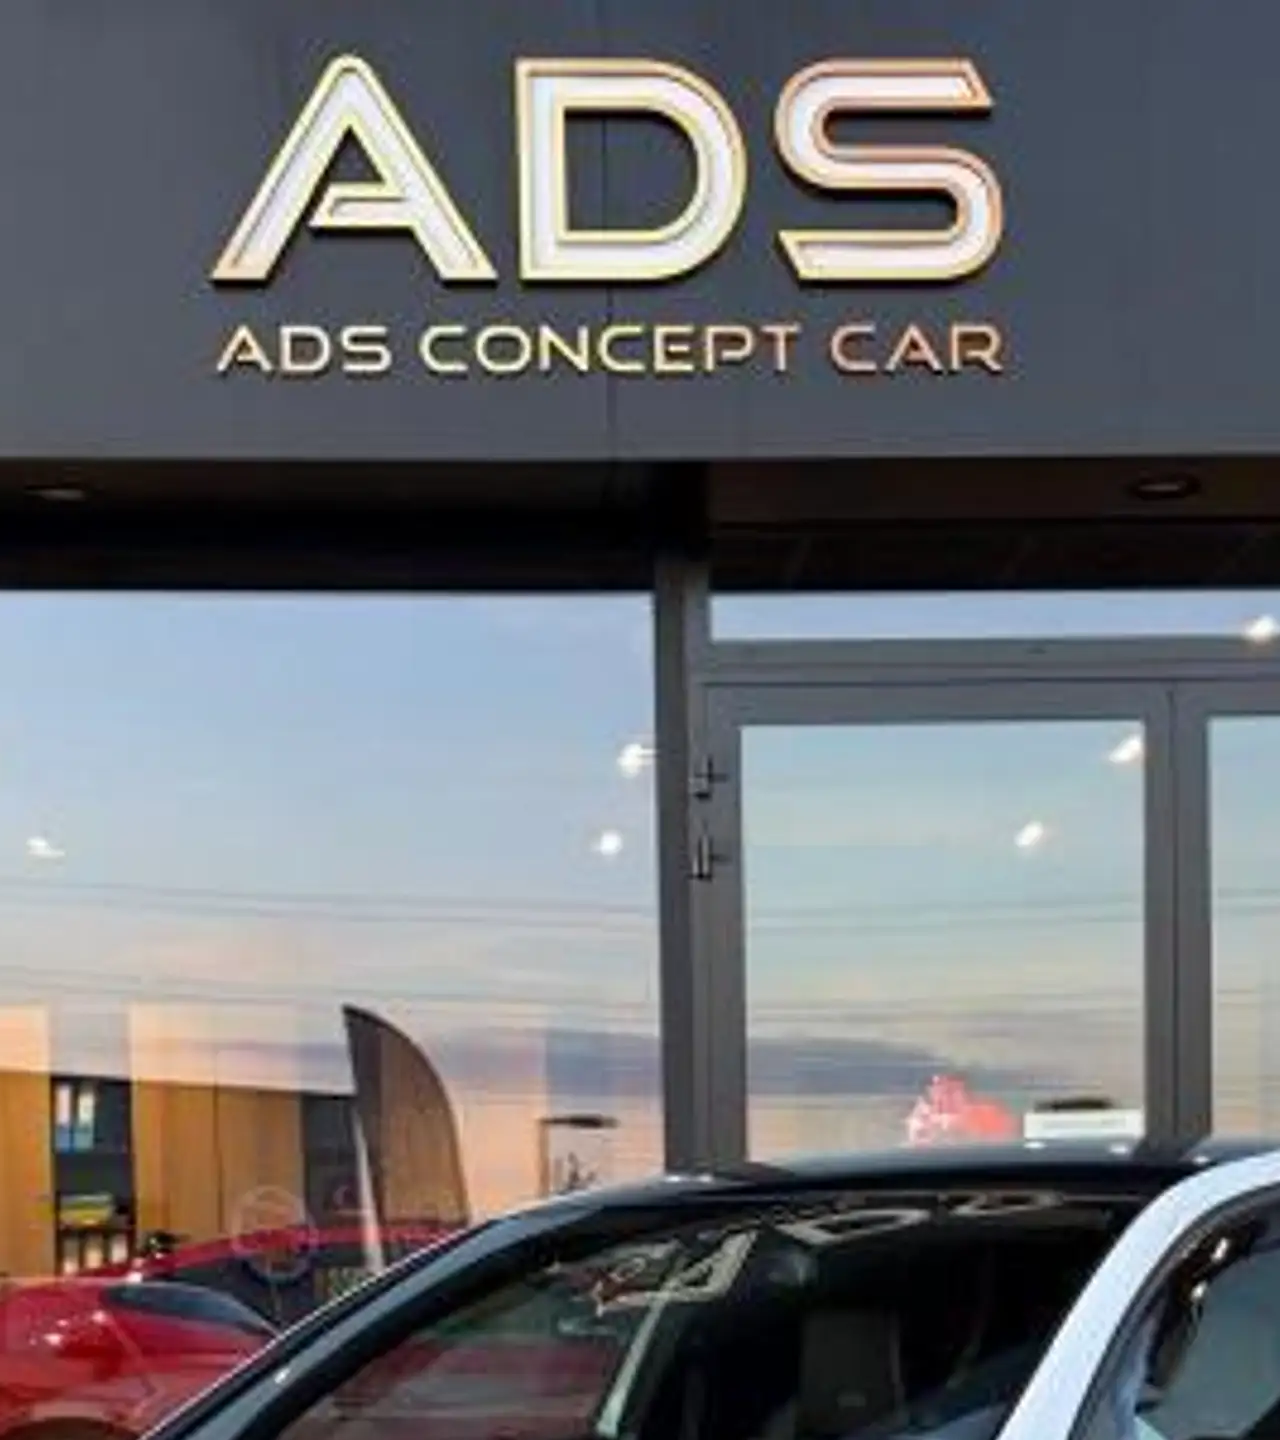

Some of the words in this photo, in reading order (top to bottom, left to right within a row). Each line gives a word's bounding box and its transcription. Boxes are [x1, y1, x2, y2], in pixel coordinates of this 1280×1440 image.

[209, 52, 1004, 283] ADS
[216, 323, 393, 376] ADS
[419, 323, 801, 376] CONCEPT
[830, 323, 1006, 376] CAR
